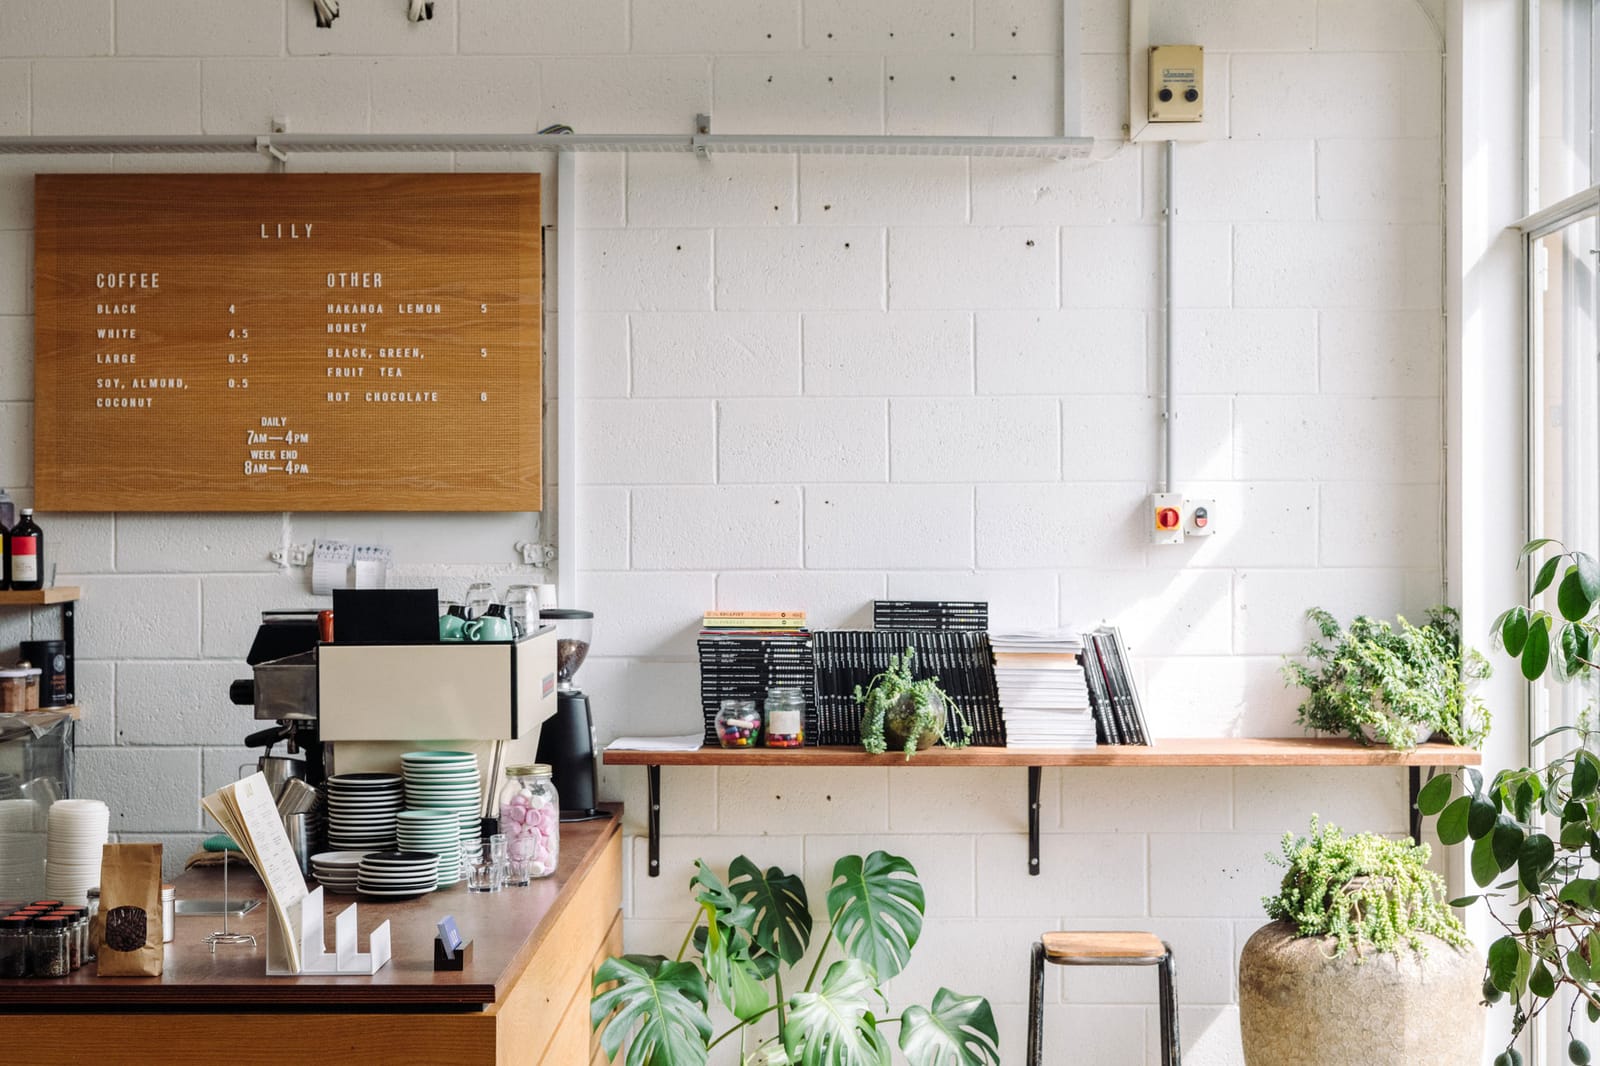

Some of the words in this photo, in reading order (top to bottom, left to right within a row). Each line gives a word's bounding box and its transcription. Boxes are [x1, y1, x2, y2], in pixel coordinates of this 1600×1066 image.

[260, 223, 313, 239] LILY
[96, 273, 160, 288] COFFEE
[326, 272, 383, 288] OTHER
[96, 304, 137, 314] BLACK
[229, 304, 236, 314] 4
[326, 303, 384, 314] HAKANOA
[398, 303, 442, 314] LEMON
[481, 303, 488, 314] 5
[96, 329, 137, 339] WHITE
[228, 329, 249, 339] 4.5
[326, 323, 367, 334] HONEY
[96, 353, 137, 364] LARGE
[228, 353, 249, 364] 0.5
[326, 348, 373, 360] BLACK,
[379, 348, 425, 360] GREEN,
[481, 348, 488, 358] 5
[326, 367, 364, 378] FRUIT
[379, 367, 403, 378] TEA
[96, 378, 127, 390] SOY,
[132, 378, 189, 390] ALMOND,
[228, 378, 249, 389] 0.5
[96, 397, 153, 408] COCONUT
[326, 392, 351, 402] HOT
[365, 392, 438, 402] CHOCOLATE
[261, 416, 287, 427] DAILY
[250, 450, 276, 460] WEEK
[280, 450, 298, 460] END
